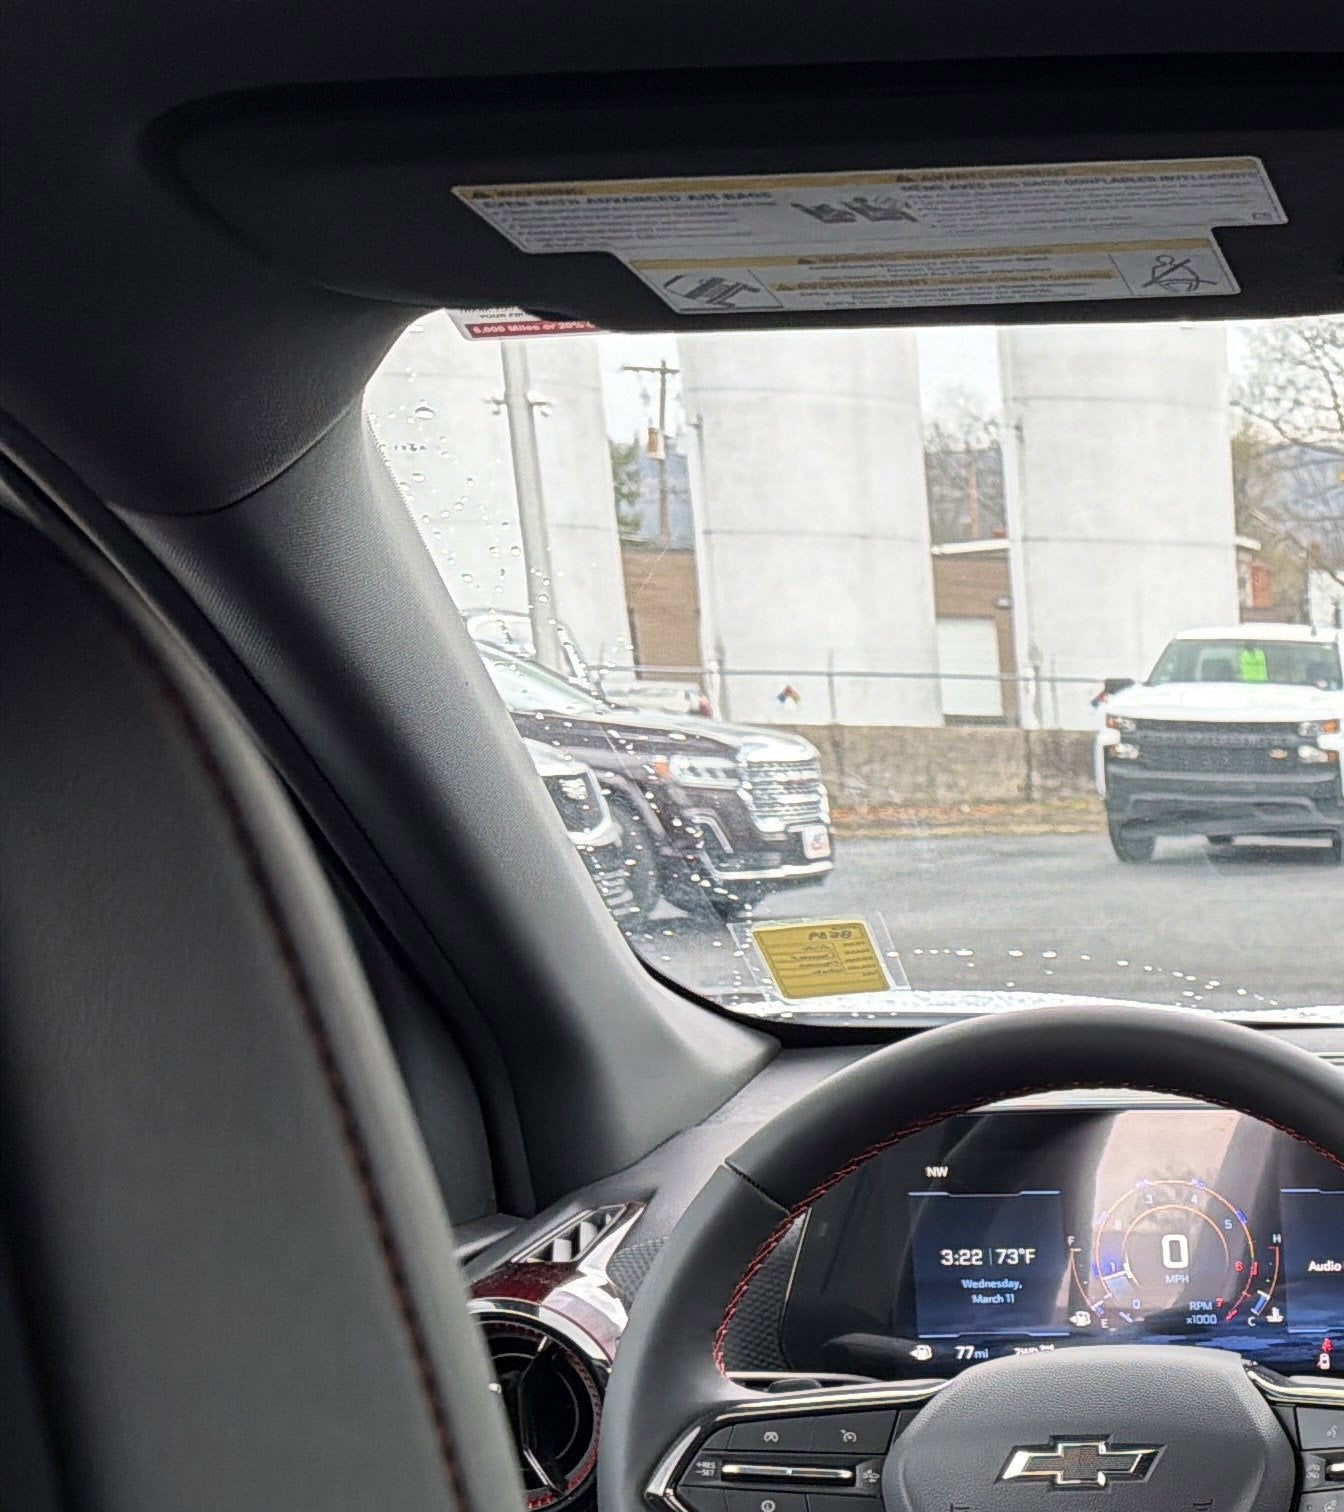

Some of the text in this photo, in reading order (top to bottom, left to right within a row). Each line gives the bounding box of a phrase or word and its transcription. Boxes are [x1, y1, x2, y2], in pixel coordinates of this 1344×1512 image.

[925, 1166, 949, 1178] NW
[1190, 1194, 1198, 1204] 4
[1067, 1235, 1075, 1245] F
[1272, 1233, 1281, 1243] H
[940, 1247, 1037, 1266] 3:22 73°F
[1161, 1233, 1189, 1269] 0
[1235, 1261, 1244, 1272] 6
[1308, 1260, 1342, 1272] Audio
[961, 1279, 1022, 1290] Wednesday,
[1165, 1275, 1190, 1284] MPH
[971, 1293, 1015, 1304] March 11
[1216, 1297, 1224, 1308] 7
[1189, 1301, 1213, 1311] RPM
[1101, 1318, 1109, 1329] E
[1186, 1314, 1218, 1325] x1000
[1247, 1317, 1256, 1326] C
